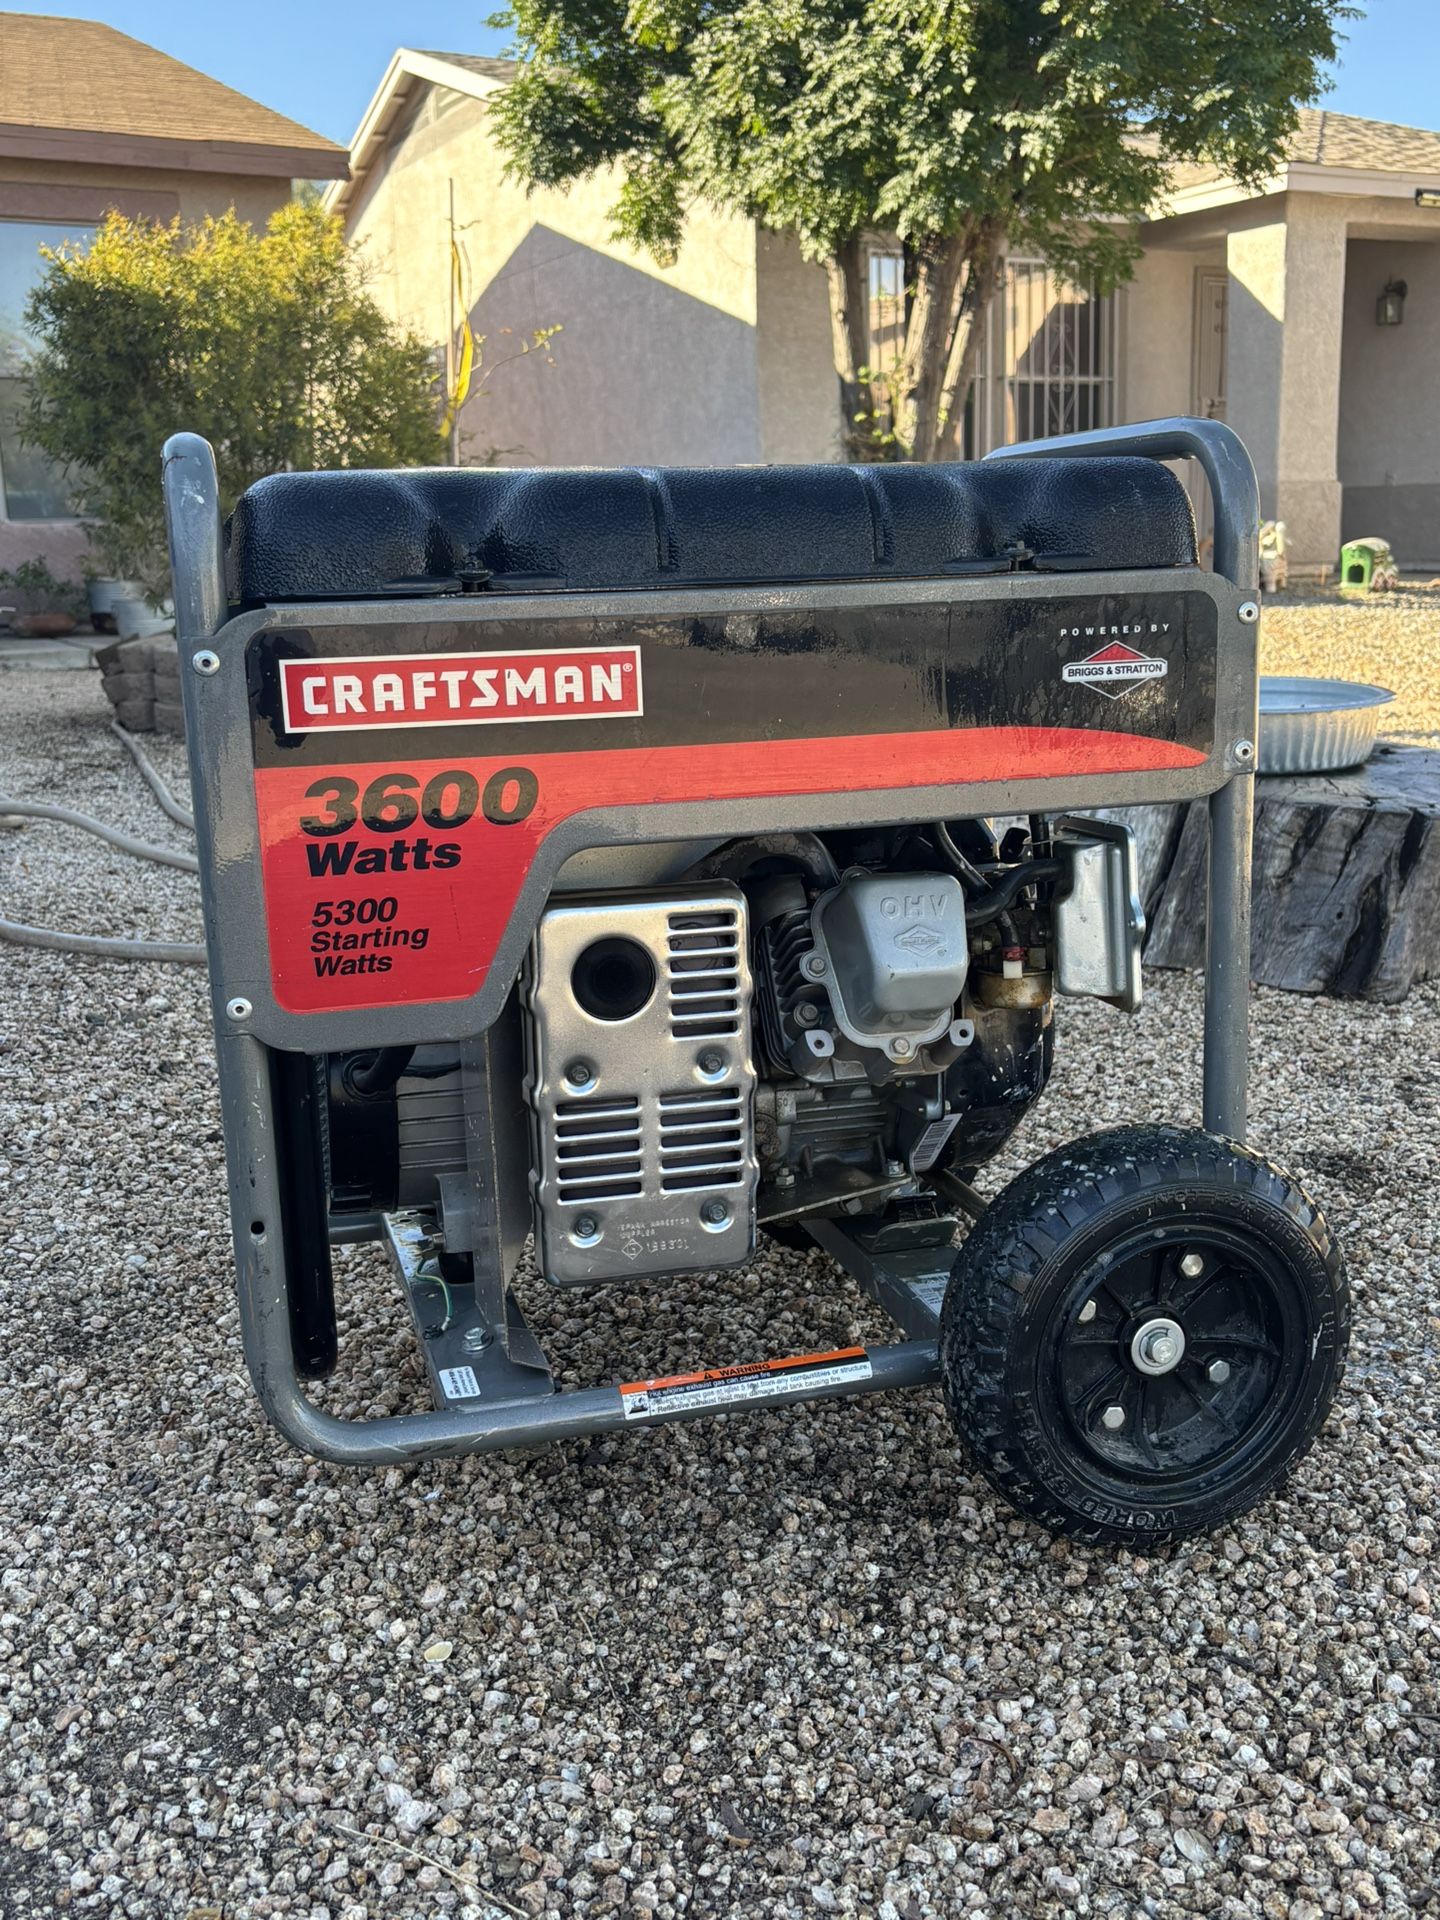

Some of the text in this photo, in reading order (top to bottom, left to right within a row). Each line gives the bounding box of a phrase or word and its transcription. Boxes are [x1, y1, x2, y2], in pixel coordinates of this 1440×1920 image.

[1060, 623, 1171, 637] POWERED BY
[1067, 663, 1163, 677] BRIGGS & STRATTON
[299, 767, 540, 837] 3600
[305, 839, 462, 878] Watts
[311, 897, 398, 928] 5300
[880, 895, 949, 920] OHV
[311, 926, 430, 953] Starting
[313, 953, 393, 978] Watts
[686, 1381, 713, 1391] exhaust
[713, 1379, 726, 1387] gas
[740, 1373, 759, 1382] cause
[719, 1363, 771, 1377] WARNING
[690, 1398, 717, 1408] exhaust
[733, 1391, 748, 1400] may
[749, 1387, 775, 1398] damage
[776, 1384, 789, 1392] fuel
[1080, 1495, 1177, 1531] WORLD
